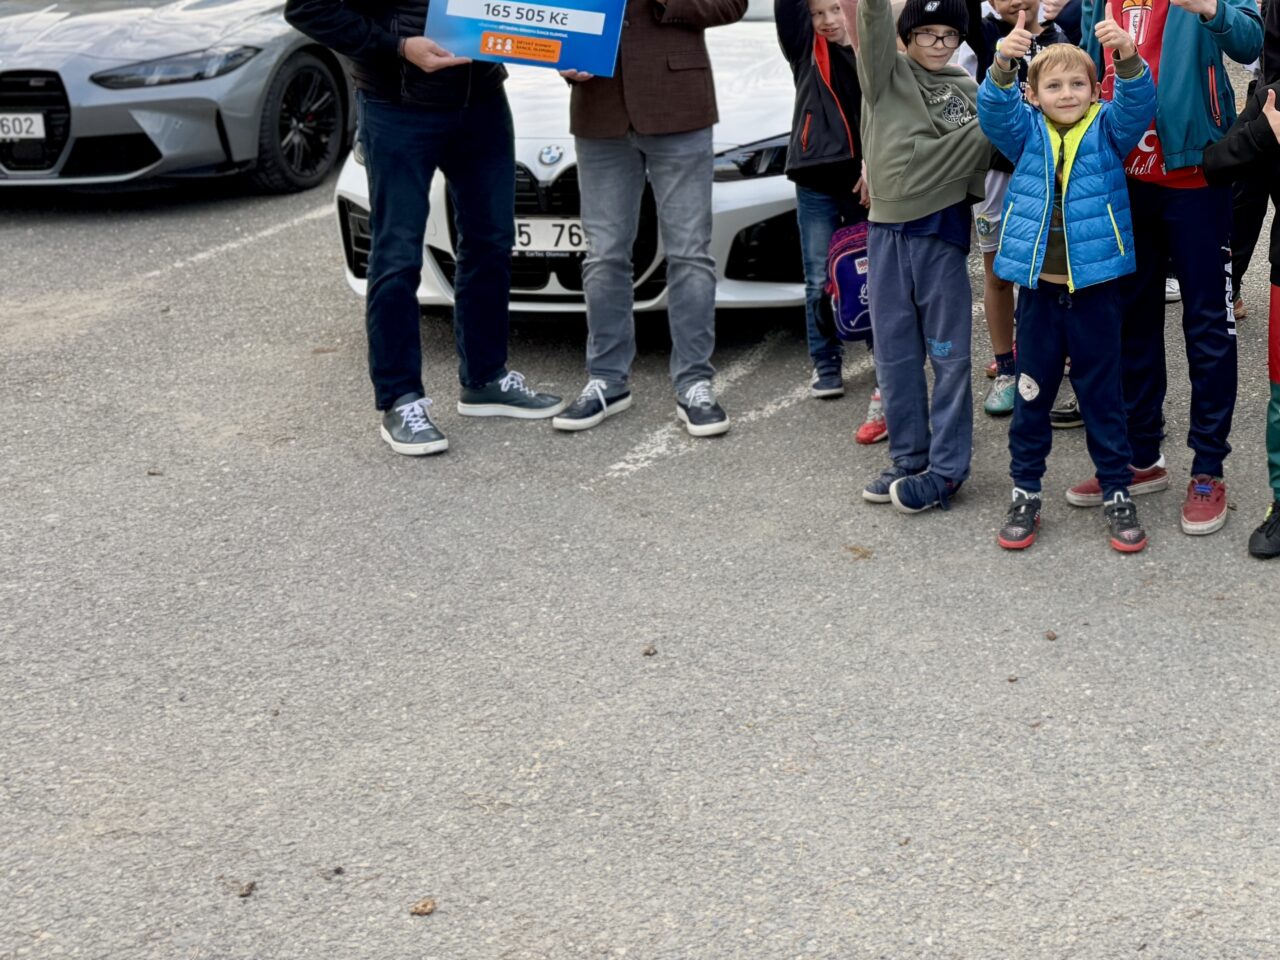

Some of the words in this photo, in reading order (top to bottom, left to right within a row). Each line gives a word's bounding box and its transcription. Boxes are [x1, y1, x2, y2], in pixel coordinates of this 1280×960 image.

[484, 3, 511, 18] 165
[515, 7, 546, 22] 505
[549, 11, 569, 26] Kč
[0, 117, 35, 135] 602
[552, 223, 588, 248] 76
